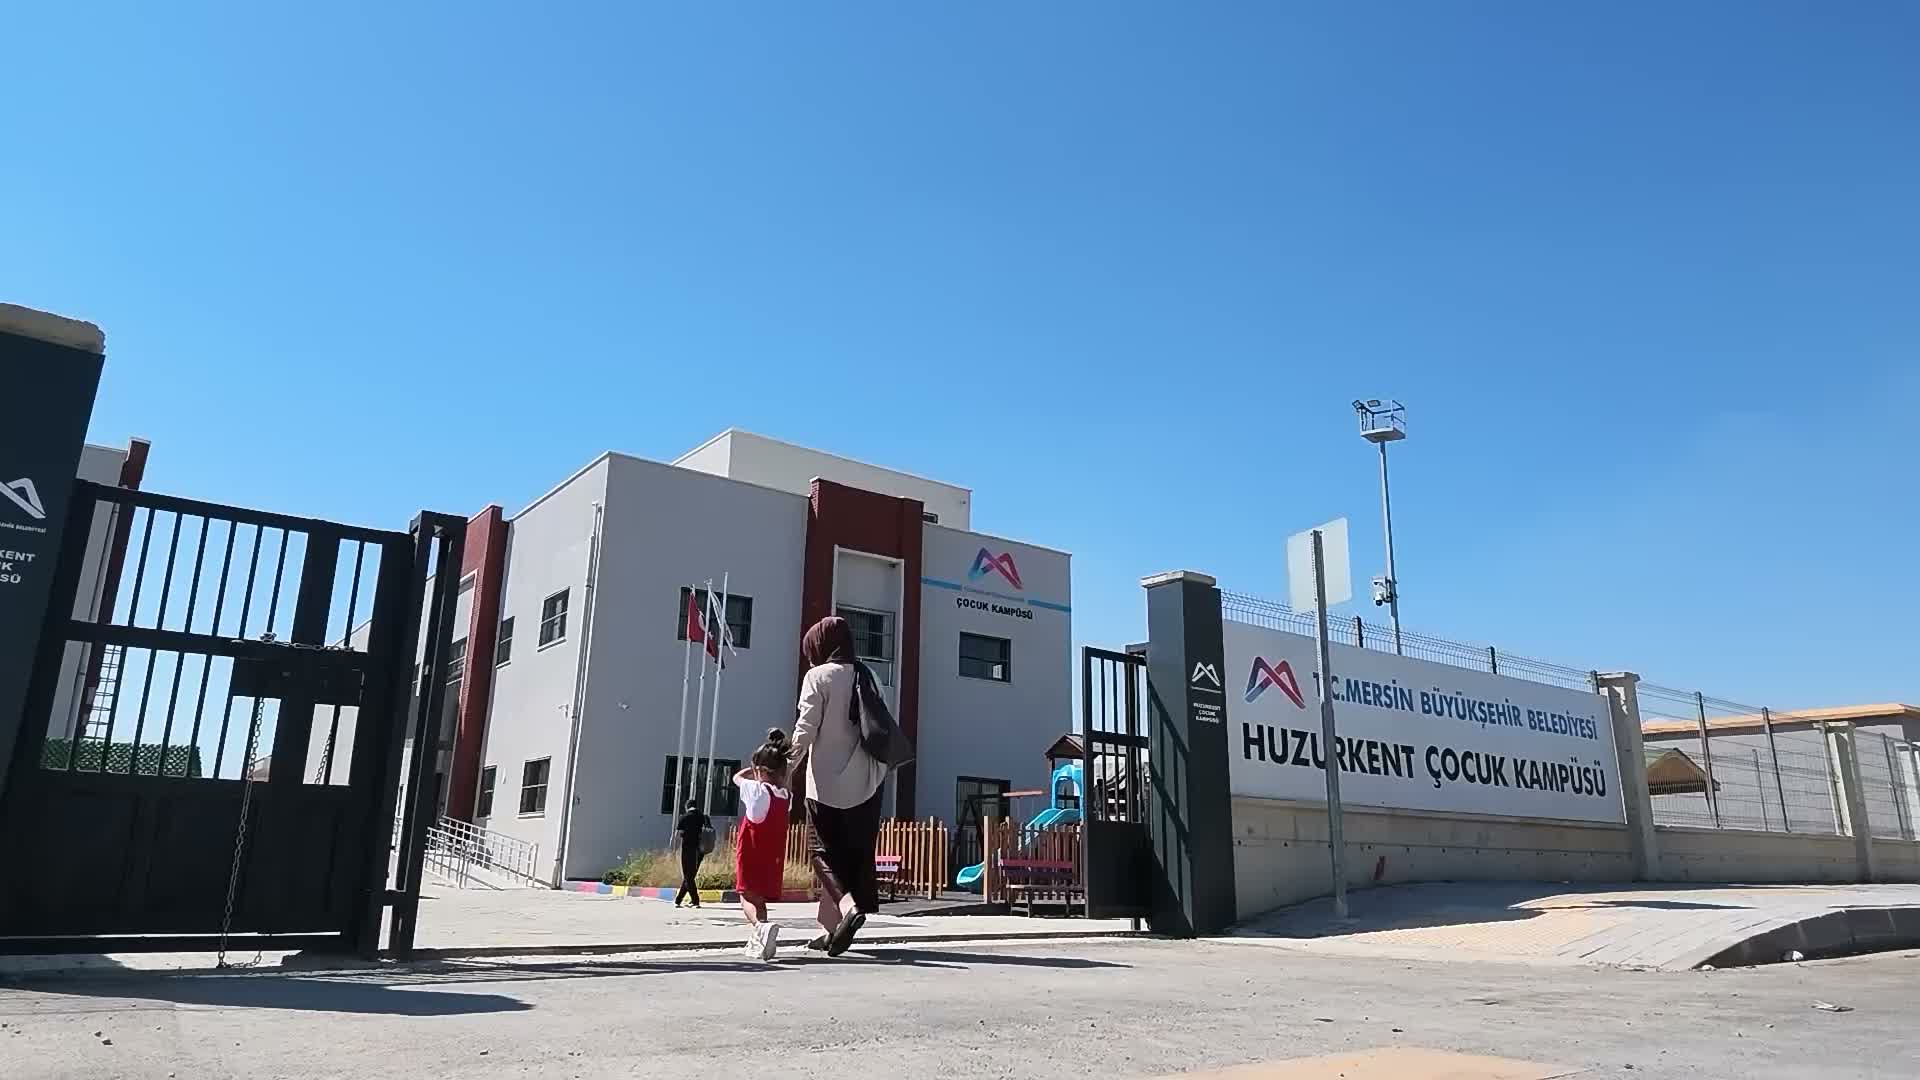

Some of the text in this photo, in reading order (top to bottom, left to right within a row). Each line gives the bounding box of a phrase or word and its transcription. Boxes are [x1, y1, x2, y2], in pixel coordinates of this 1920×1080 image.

[956, 598, 1033, 620] ÇOCUK KAMPÜSÜ
[1312, 672, 1598, 740] TC.MERSİN BÜYÜKŞEHİR BELEDİYESİ
[1242, 722, 1606, 797] HUZURKENT ÇOCUK KAMPÜSÜ
